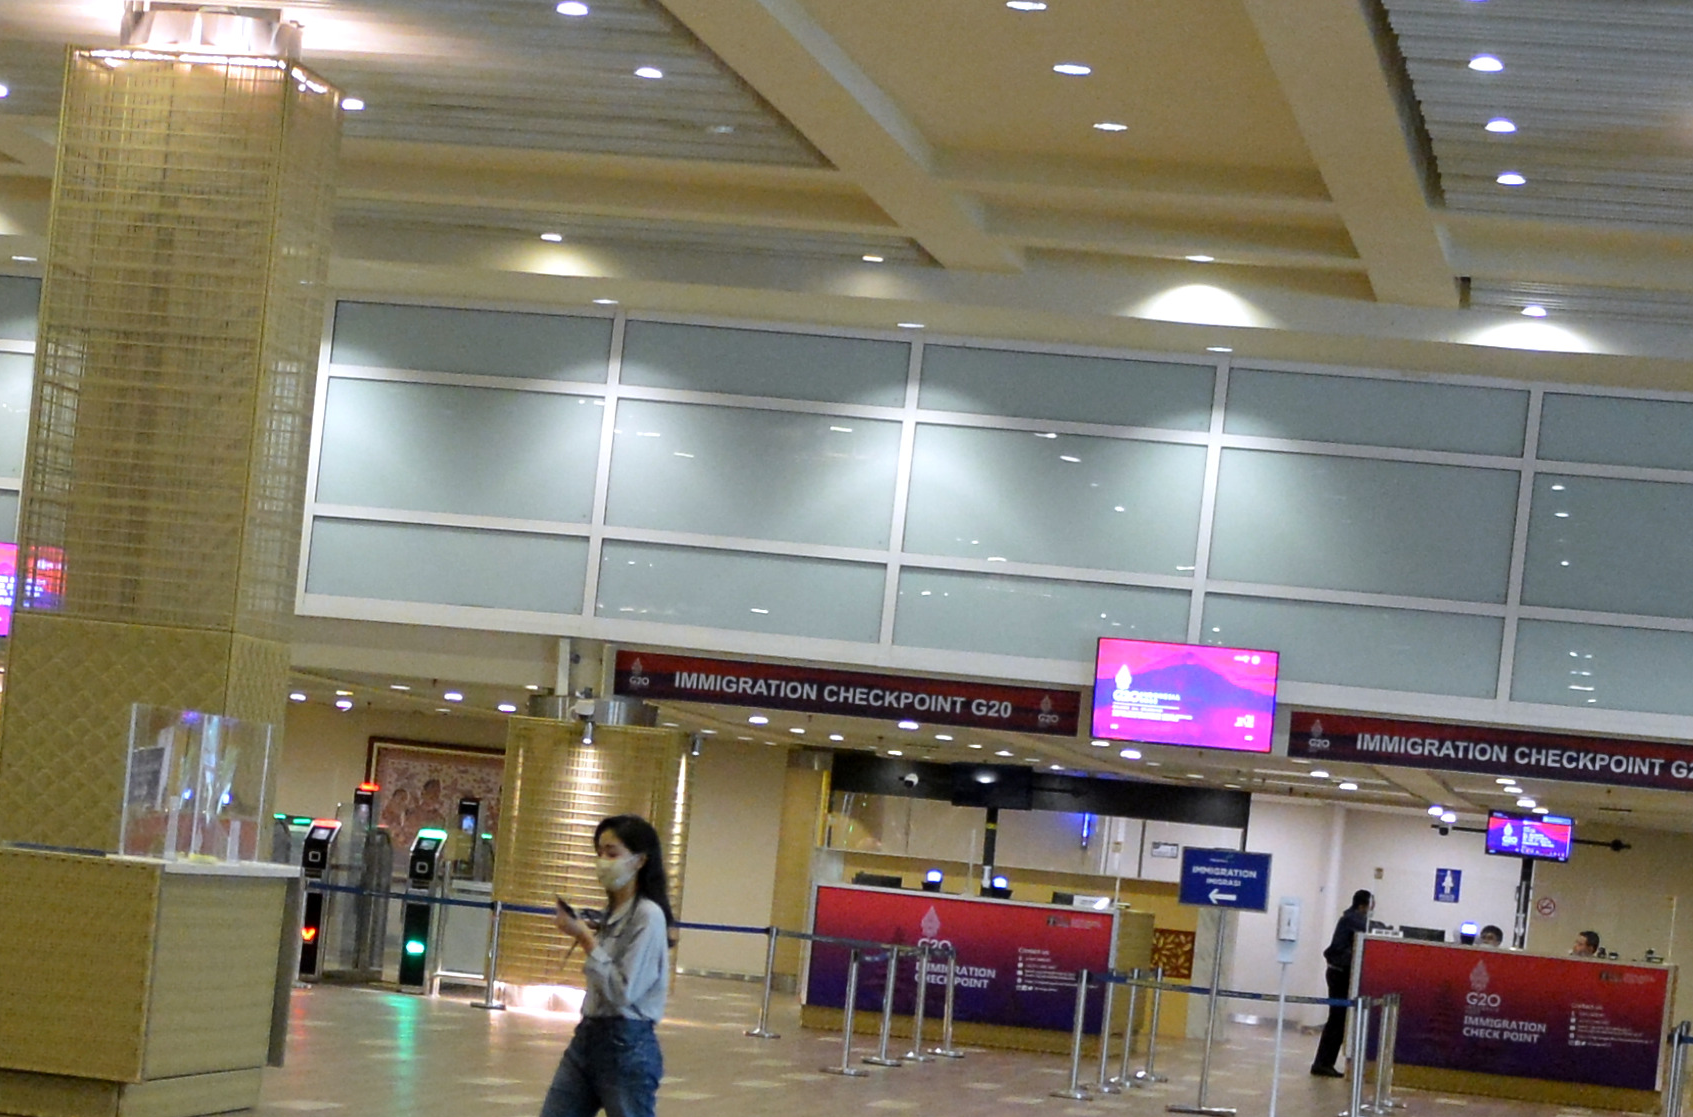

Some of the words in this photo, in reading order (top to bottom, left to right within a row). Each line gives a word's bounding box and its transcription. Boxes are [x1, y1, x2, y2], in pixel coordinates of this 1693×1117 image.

[674, 671, 818, 700] IMMIGRATION
[823, 685, 966, 714] CHECKPOINT
[971, 699, 1013, 719] G20
[1357, 732, 1508, 763] IMMIGRATION
[1514, 747, 1665, 777] CHECKPOINT
[1192, 866, 1257, 878] IMMIGRATION
[915, 962, 996, 978] IMIRATION
[954, 977, 989, 989] POINT
[1466, 991, 1501, 1007] G20
[1464, 1015, 1547, 1033] IMMIGRATION
[1462, 1027, 1500, 1039] CHECK
[1503, 1031, 1540, 1044] POINT
